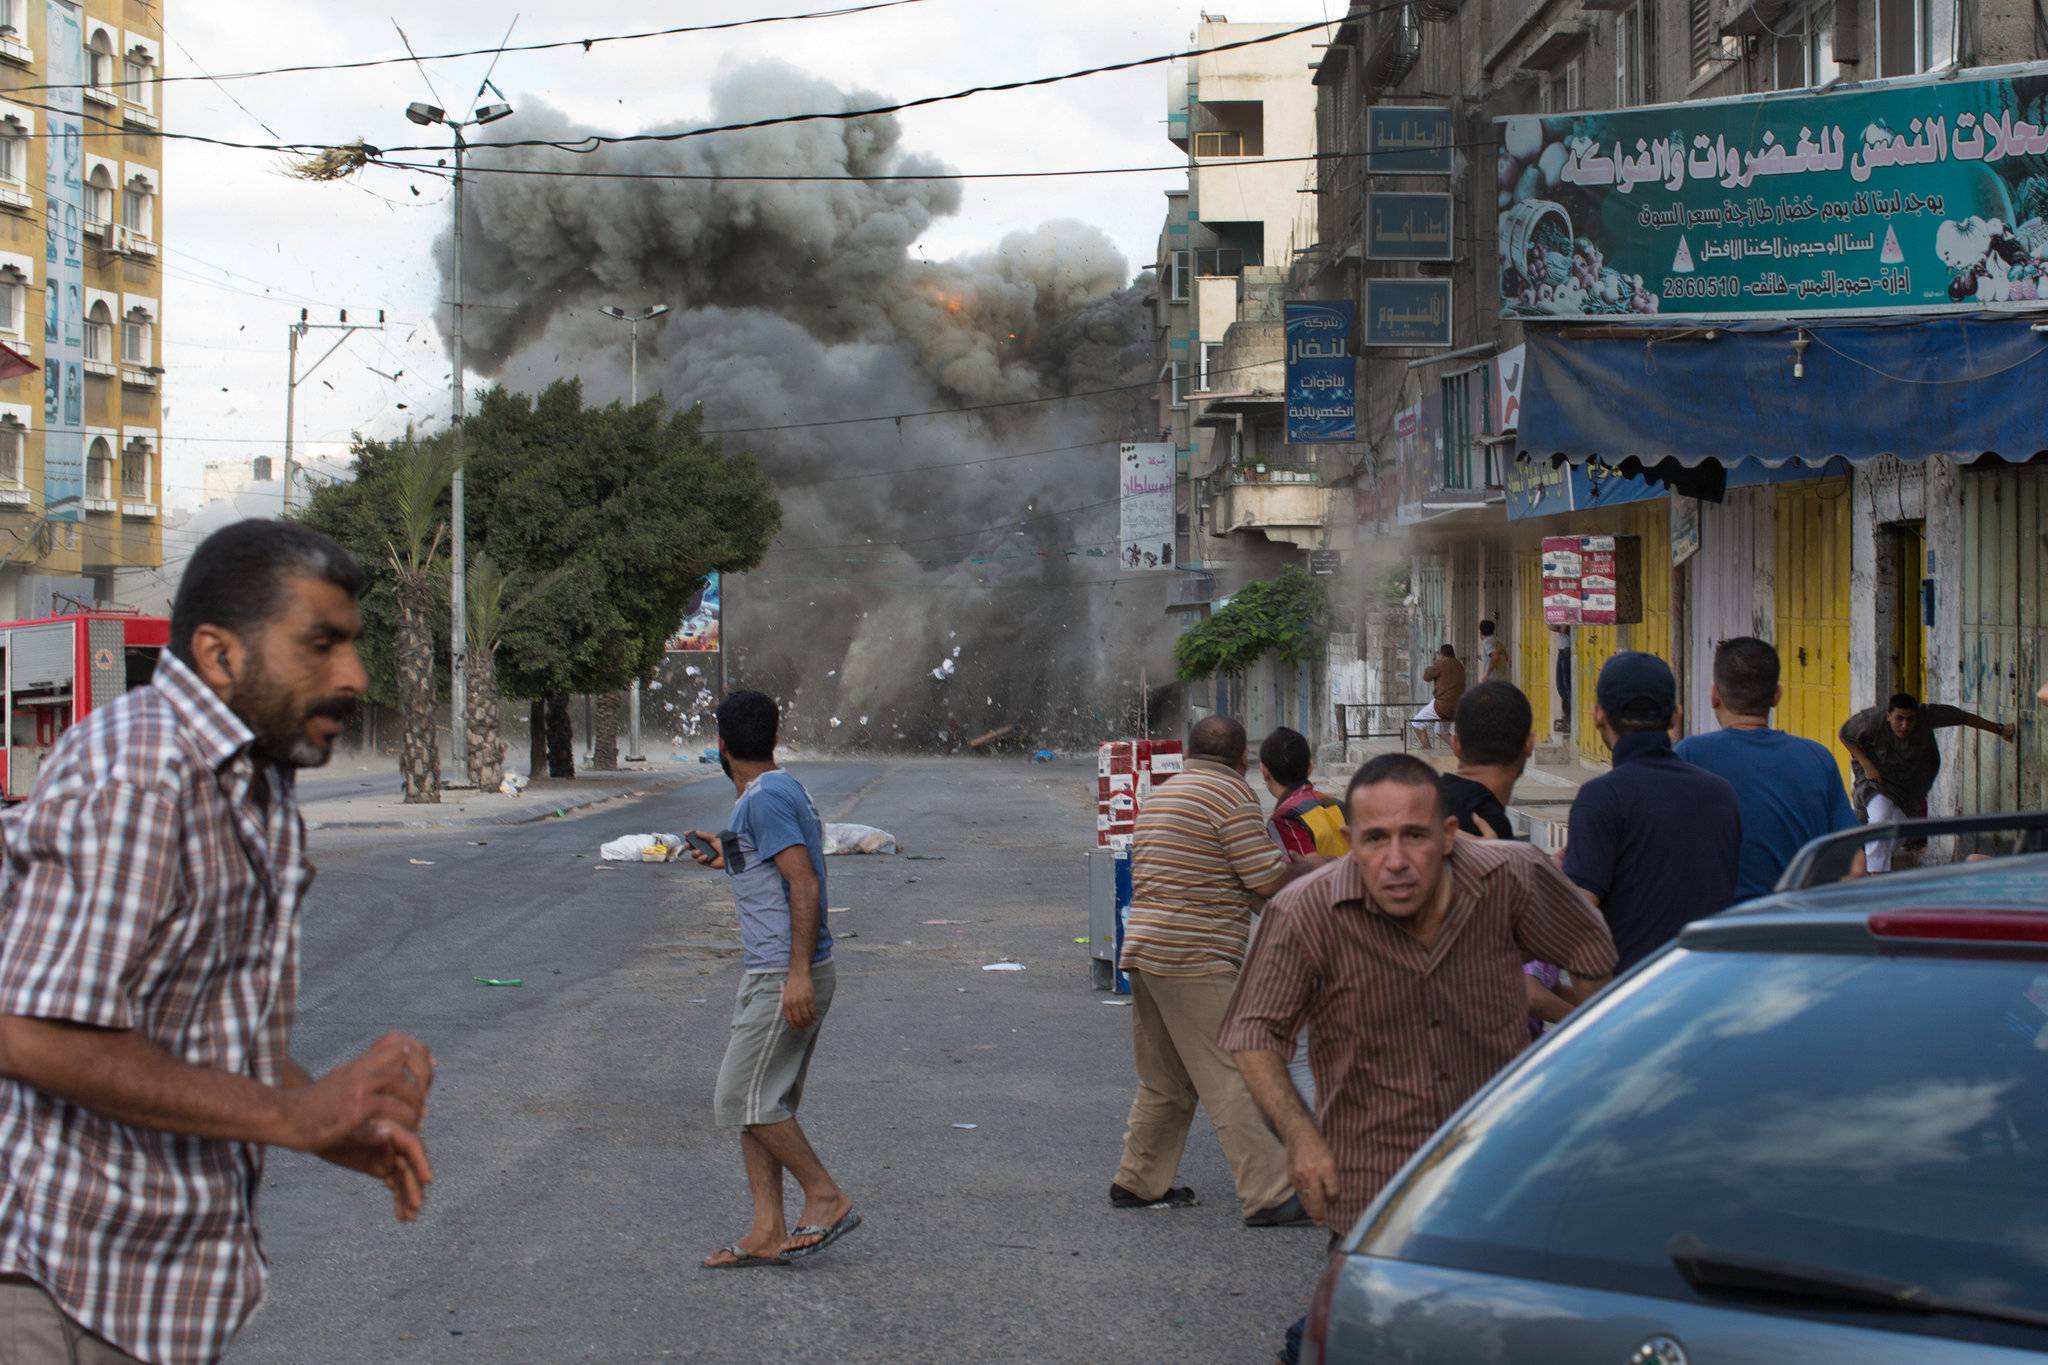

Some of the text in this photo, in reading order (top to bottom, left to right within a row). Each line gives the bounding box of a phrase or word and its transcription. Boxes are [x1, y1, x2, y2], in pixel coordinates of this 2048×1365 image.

[1851, 115, 1947, 182] النمس
[1952, 109, 2048, 162] حلات
[1688, 125, 1845, 188] للخضروات
[1638, 189, 1945, 230] يوجد لدينا كل يوم خضار طازجة بسعر السوق
[1700, 239, 1742, 262] الافضل
[1783, 233, 1844, 258] الوحيدون
[1845, 231, 1875, 251] لسنا
[1662, 275, 1740, 299] 2860510
[1751, 272, 1788, 297] هاتف
[1797, 270, 1837, 301] النمس
